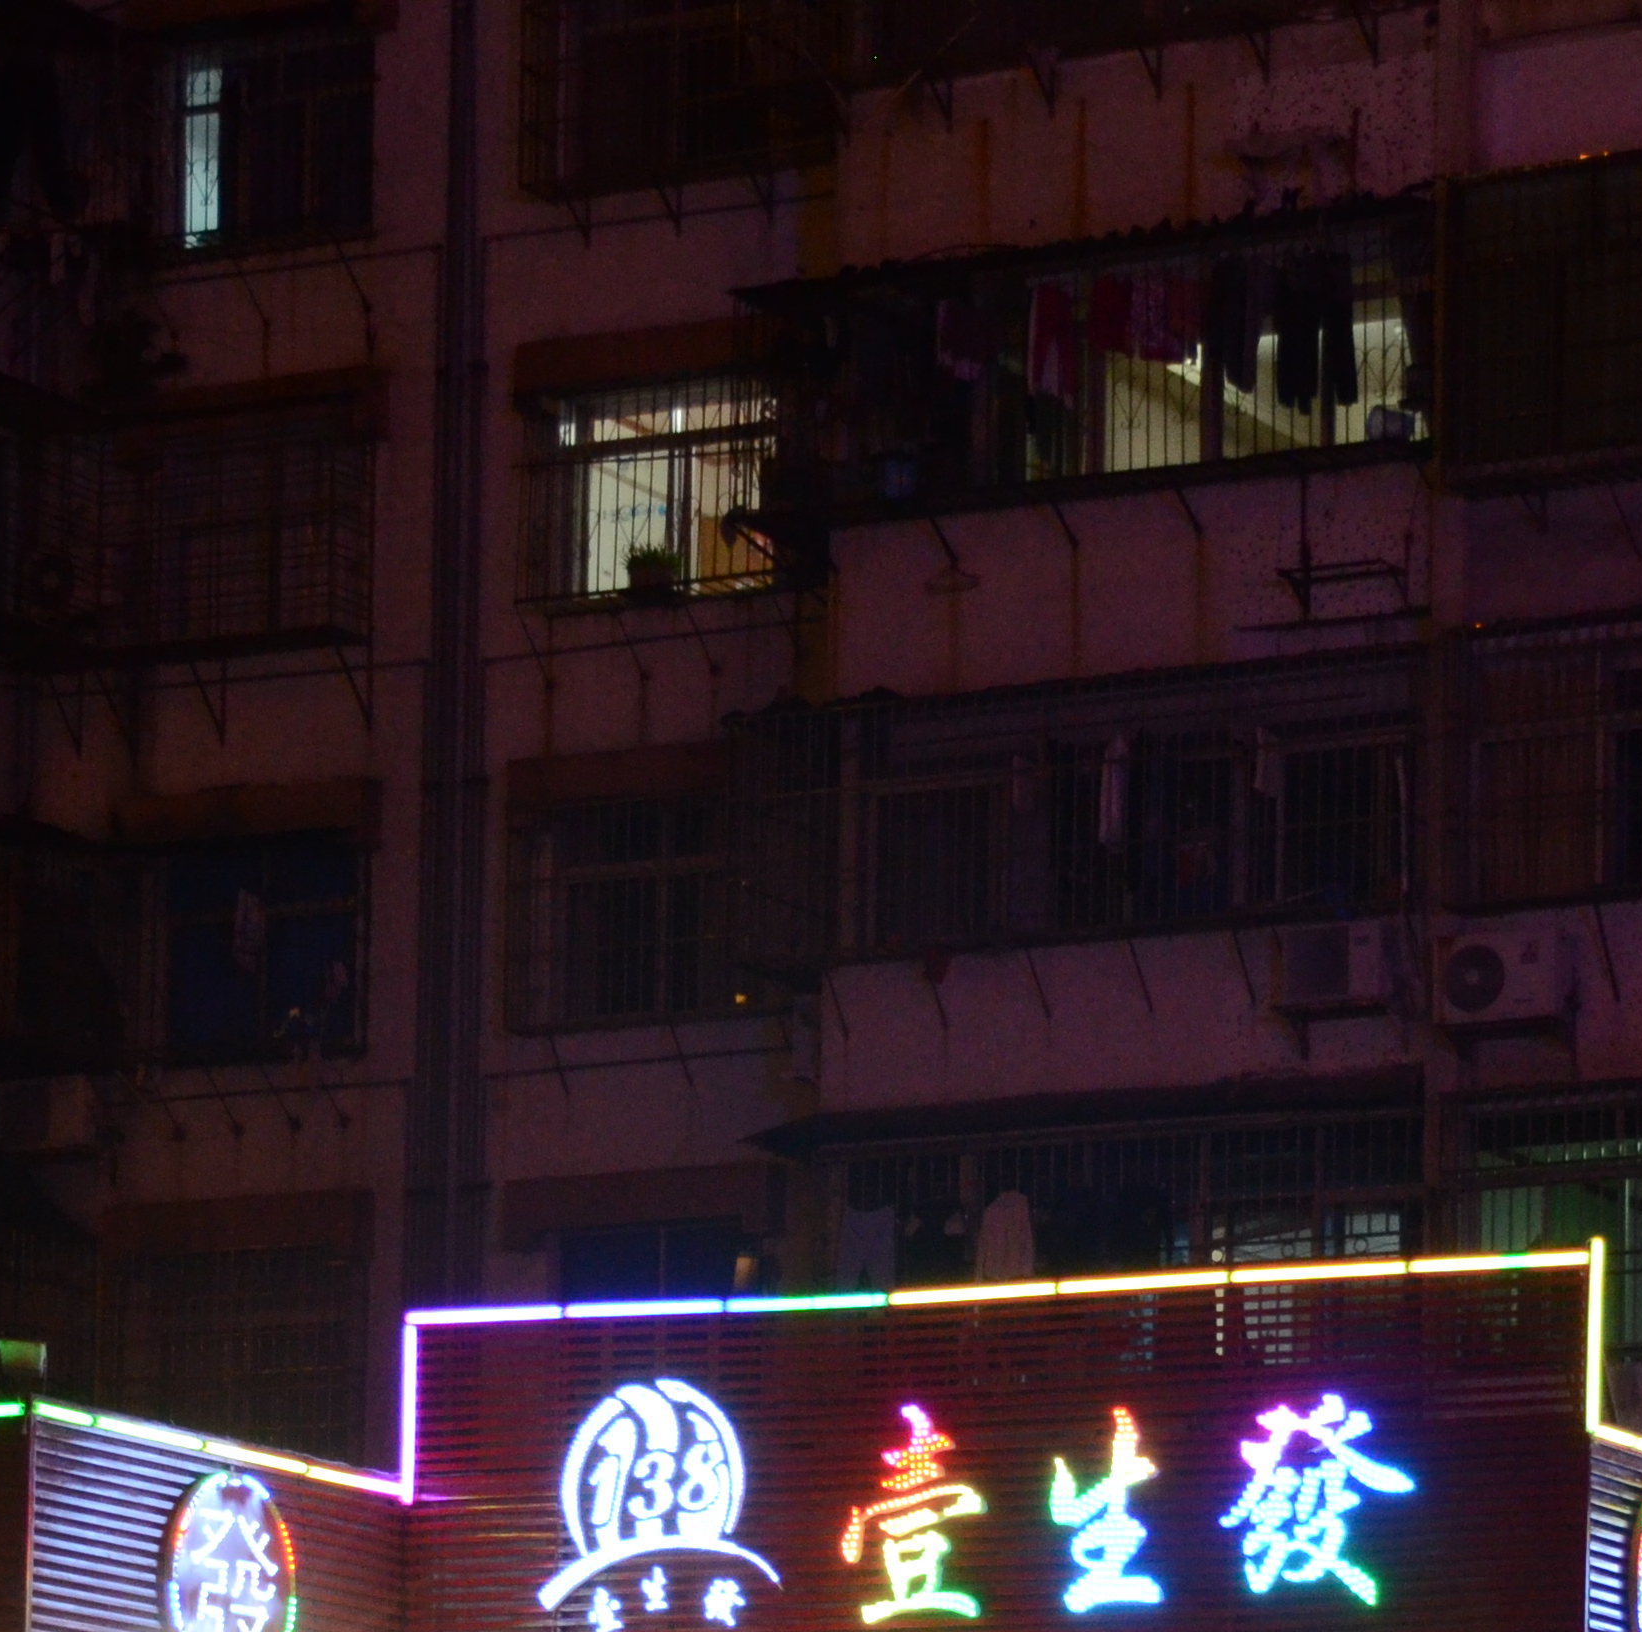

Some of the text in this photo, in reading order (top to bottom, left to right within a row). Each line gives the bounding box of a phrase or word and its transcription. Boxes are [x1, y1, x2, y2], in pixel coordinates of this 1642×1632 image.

[587, 1440, 727, 1527] 138
[840, 1391, 1417, 1626] 壹生發
